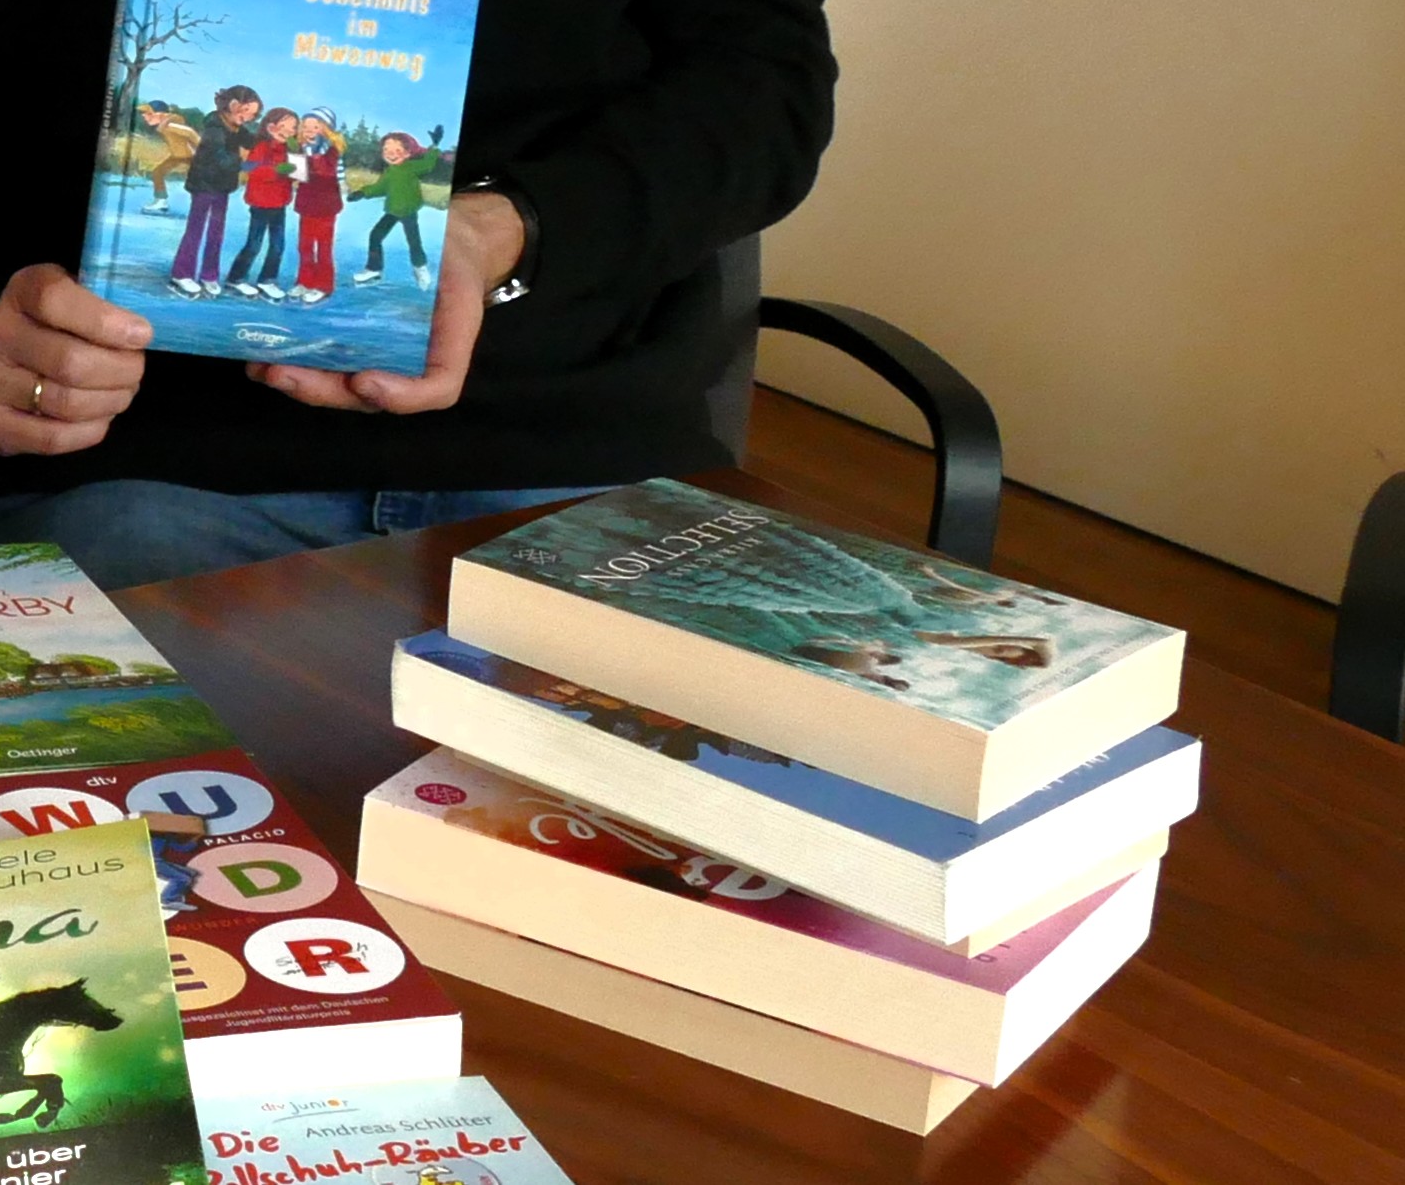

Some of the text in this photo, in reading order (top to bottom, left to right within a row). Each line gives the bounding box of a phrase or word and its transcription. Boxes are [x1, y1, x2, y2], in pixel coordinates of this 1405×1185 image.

[347, 11, 379, 37] im
[578, 508, 770, 588] SELECTION
[7, 746, 78, 760] Oetinger
[87, 775, 118, 788] dtv
[203, 828, 287, 846] PALACIO
[182, 995, 389, 1023] usgezeichnet mit dem Deutschen
[305, 1115, 493, 1138] Andreas Schlüter
[7, 1144, 86, 1168] über
[207, 1131, 279, 1159] Die
[207, 1131, 528, 1185] llschuh-Räuber
